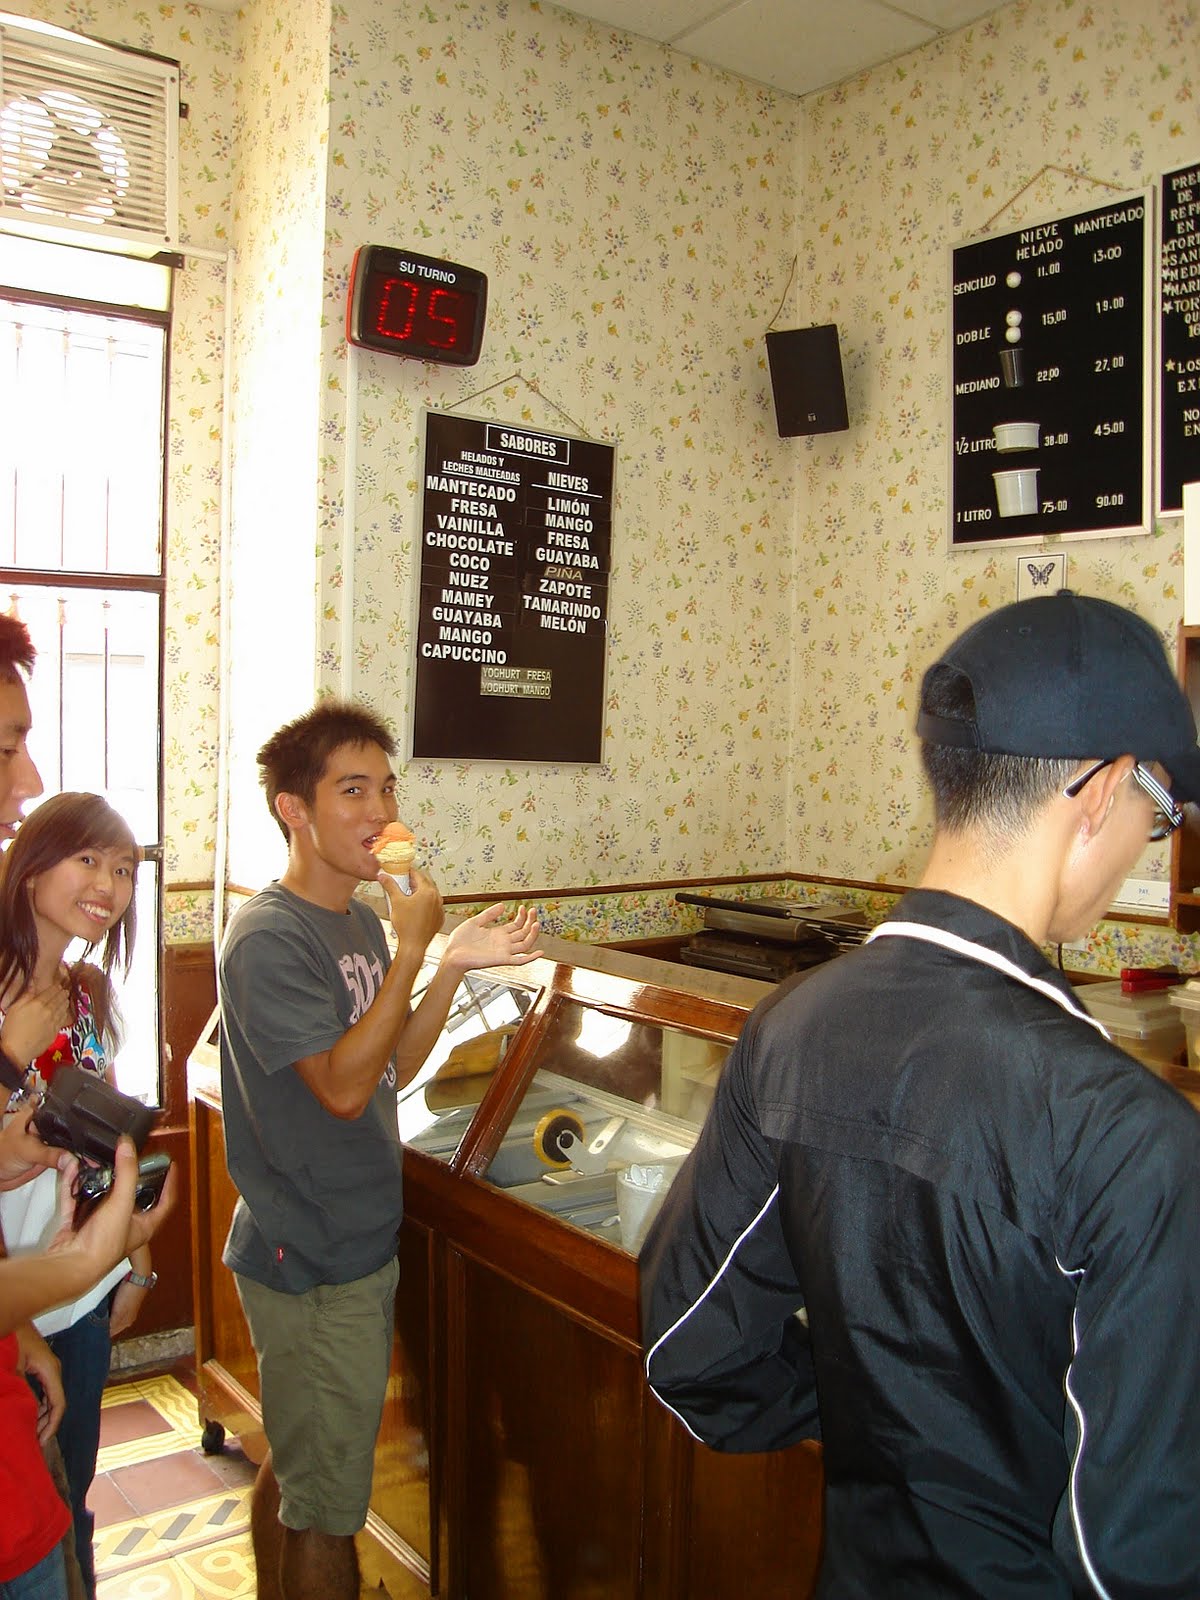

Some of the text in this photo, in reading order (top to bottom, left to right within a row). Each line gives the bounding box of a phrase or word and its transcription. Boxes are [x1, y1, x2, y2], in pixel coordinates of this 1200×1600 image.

[1177, 189, 1193, 204] DE
[1074, 206, 1144, 236] MANTECADO
[1177, 219, 1194, 234] EN
[1020, 224, 1059, 244] NIEVE
[1016, 239, 1063, 261] HELADO
[1170, 249, 1200, 267] SAN
[400, 261, 456, 284] SU TURNO
[1037, 262, 1060, 277] 11.00
[953, 274, 997, 296] SENCILLO
[377, 279, 458, 349] 05
[1096, 296, 1125, 314] 19.00
[1042, 310, 1067, 325] 15.00
[957, 327, 991, 345] DOBLE
[1095, 356, 1124, 372] 27.00
[1037, 368, 1060, 382] 22.00
[956, 377, 1000, 395] MEDIANO
[1178, 377, 1200, 393] EX
[1094, 421, 1125, 437] 45.00
[500, 433, 557, 457] SABORES
[971, 438, 997, 453] LITRO
[461, 451, 505, 467] HELADOS Y
[443, 461, 521, 482] LECHES MALTEADAS
[426, 475, 516, 502] MANTECADO
[548, 472, 589, 492] NIEVES
[451, 498, 497, 518] FRESA
[548, 497, 590, 516] LIMÓN
[1042, 500, 1068, 514] 75.00
[1096, 494, 1124, 508] 90.00
[545, 513, 593, 533] MANGO
[956, 508, 992, 523] 1 LITRO
[437, 514, 505, 537] VAINILLA
[426, 532, 514, 556] CHOCOLATE
[547, 531, 590, 550] FRESA
[449, 552, 490, 571] COCO
[535, 547, 599, 570] GUAYABA
[449, 572, 489, 590] NUEZ
[543, 566, 583, 581] PIÑA
[539, 579, 592, 599] ZAPOTE
[441, 589, 495, 609] MAMEY
[522, 595, 601, 620] TAMARINDO
[432, 606, 502, 628] GUAYABA
[540, 614, 587, 634] MELÓN
[439, 626, 492, 645] MANGO
[421, 643, 507, 664] CAPUCCINO
[482, 667, 551, 681] YOGHURT FRESA
[482, 682, 550, 696] YOGHURT MANGO
